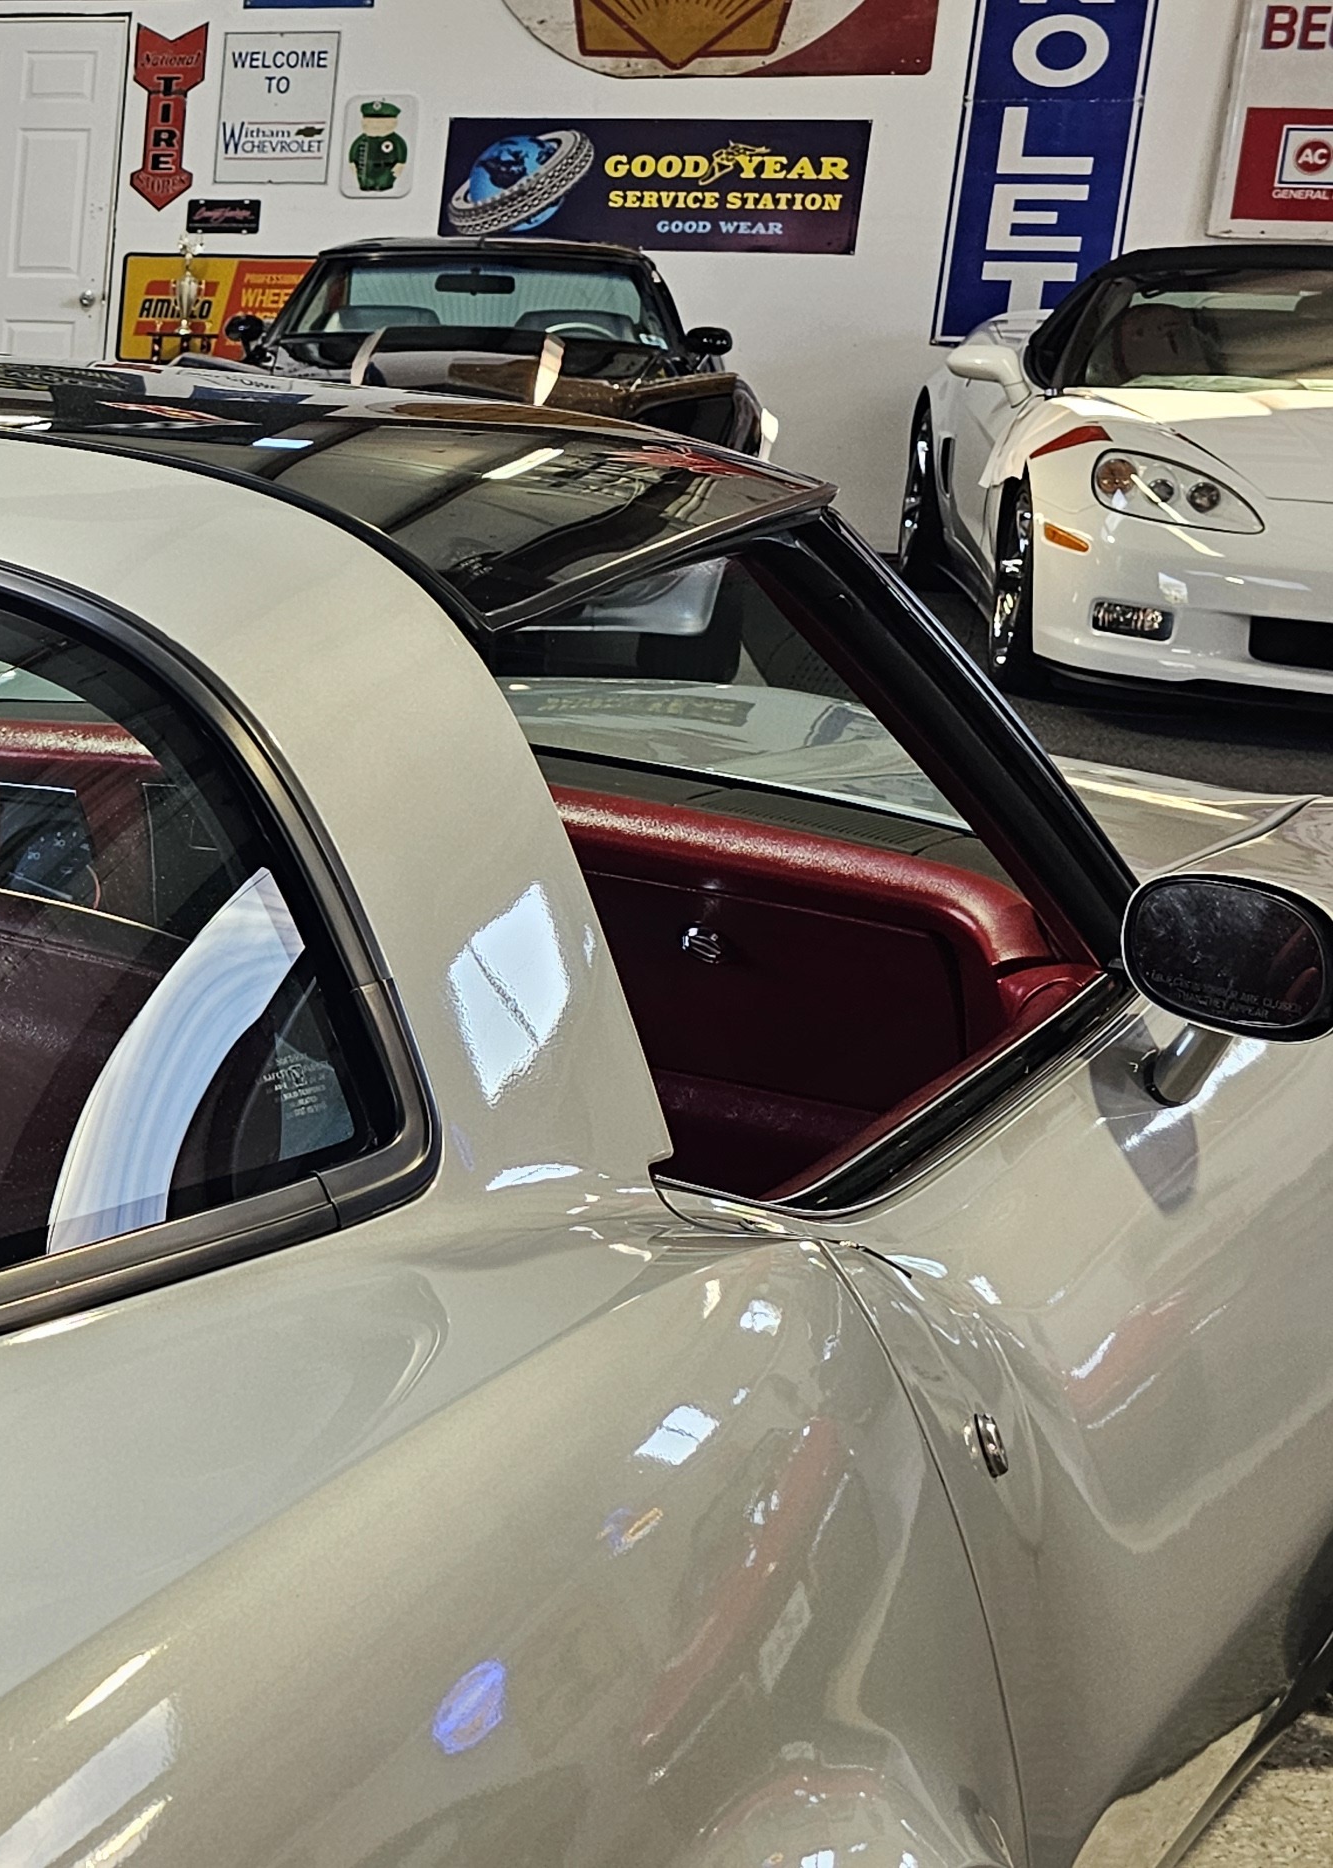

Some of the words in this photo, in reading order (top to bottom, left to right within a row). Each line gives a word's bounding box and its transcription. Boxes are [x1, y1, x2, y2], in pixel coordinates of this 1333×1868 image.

[1261, 5, 1333, 50] BE
[141, 51, 201, 67] National
[232, 50, 329, 69] WELCOME
[265, 76, 291, 94] TO
[150, 75, 182, 171] TIRE
[222, 121, 291, 154] Witham
[241, 139, 325, 154] CHEVROLET
[981, 0, 1110, 313] OLET
[1297, 148, 1329, 165] AC
[136, 174, 188, 195] STORES
[608, 190, 720, 209] SERVICE
[725, 192, 843, 211] STATION
[1271, 189, 1330, 200] GENERAL
[656, 220, 712, 234] GOOD
[719, 221, 784, 235] WEAR
